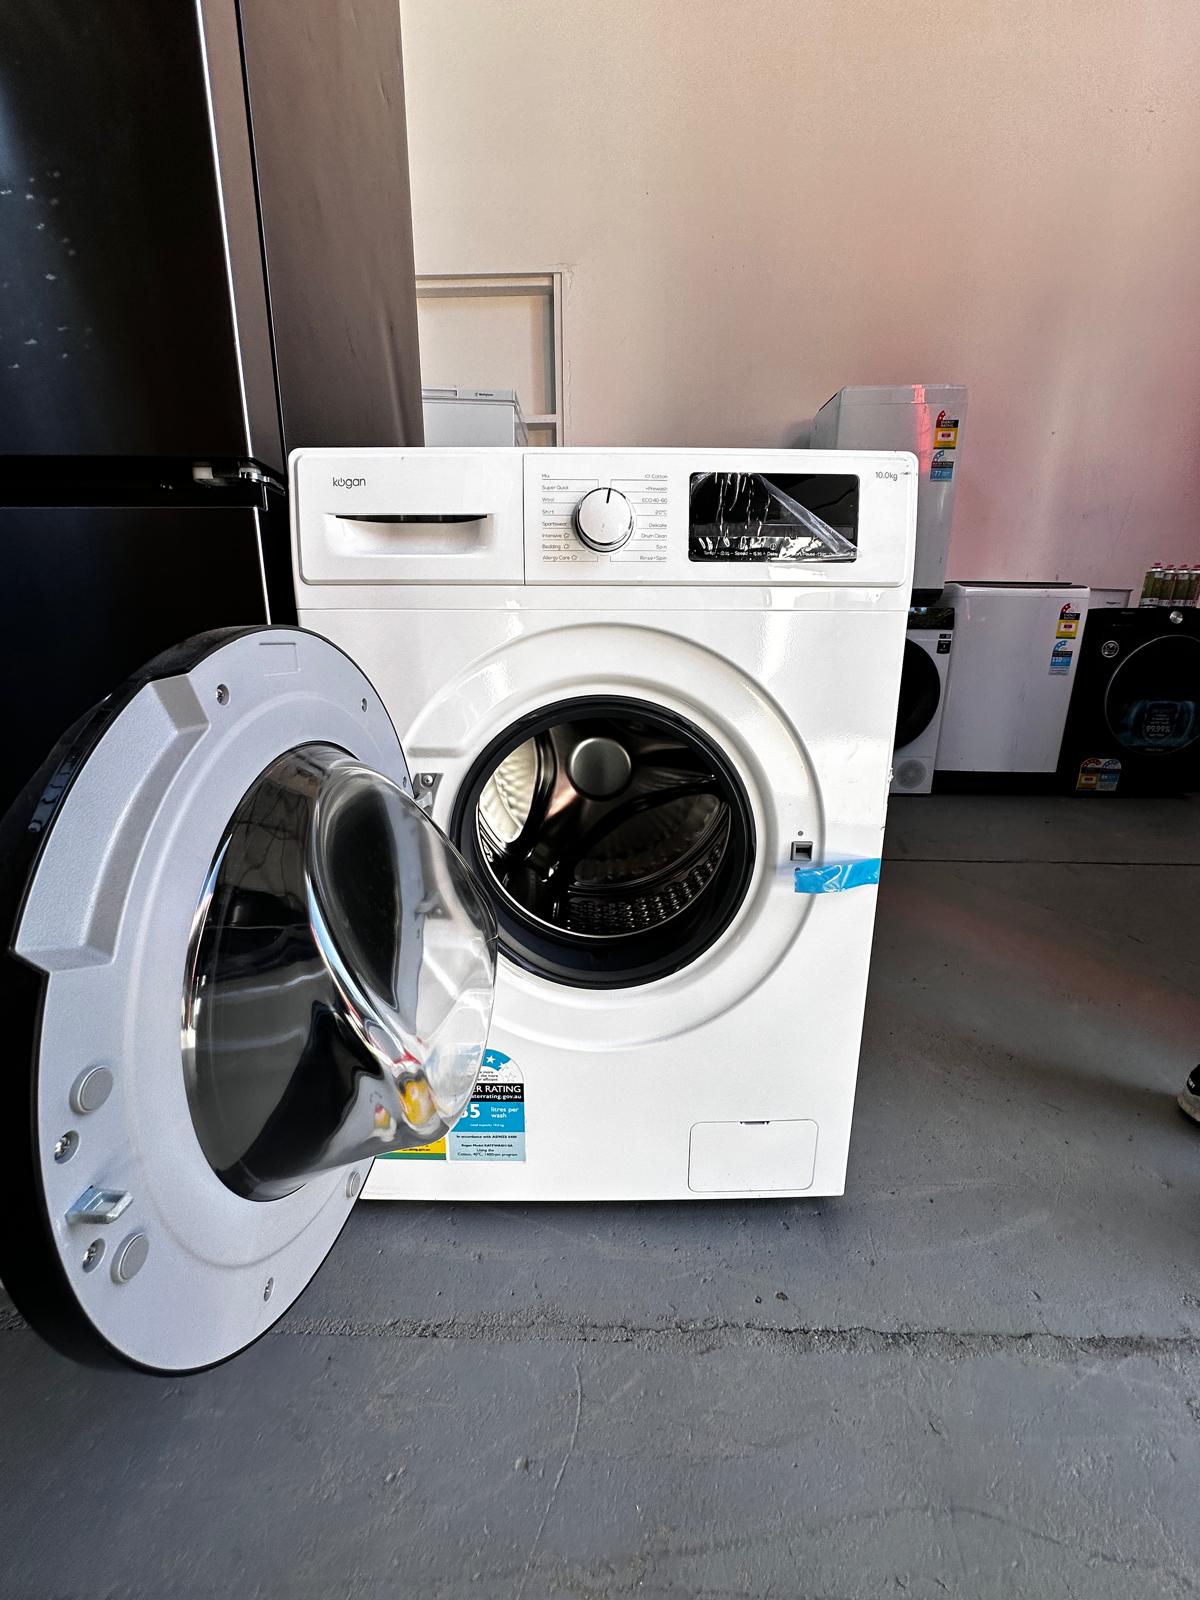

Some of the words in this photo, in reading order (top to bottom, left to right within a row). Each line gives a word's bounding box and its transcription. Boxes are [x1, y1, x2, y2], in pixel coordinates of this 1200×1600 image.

[875, 471, 898, 482] 10.0kg
[332, 477, 366, 489] kogan
[485, 1085, 521, 1093] RATING
